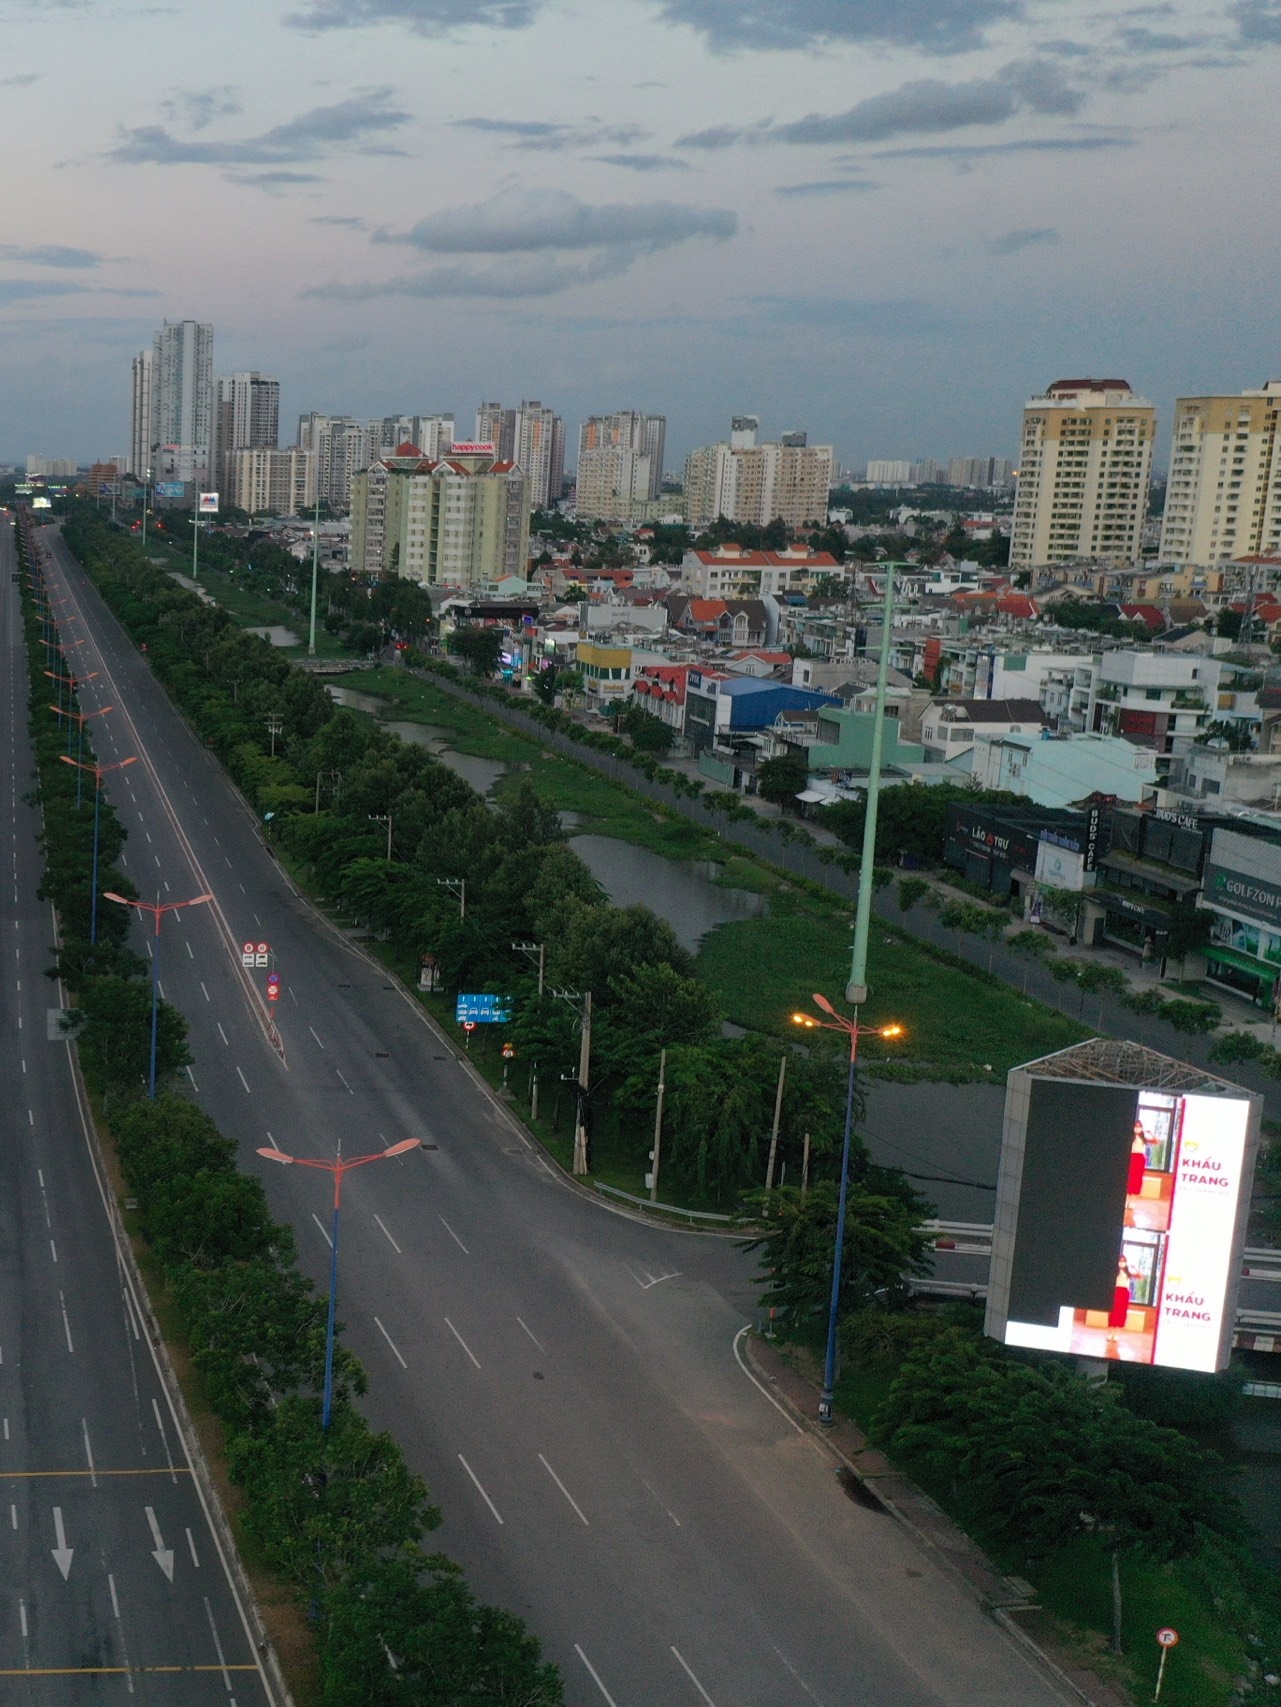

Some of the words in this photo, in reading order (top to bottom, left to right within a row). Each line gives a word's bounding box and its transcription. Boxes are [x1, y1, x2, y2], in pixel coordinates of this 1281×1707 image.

[452, 443, 493, 451] happycook
[1178, 815, 1198, 830] CAFE
[1226, 880, 1275, 907] GOLFZON
[1181, 1173, 1229, 1187] TRANG
[1164, 1307, 1211, 1321] TRANG
